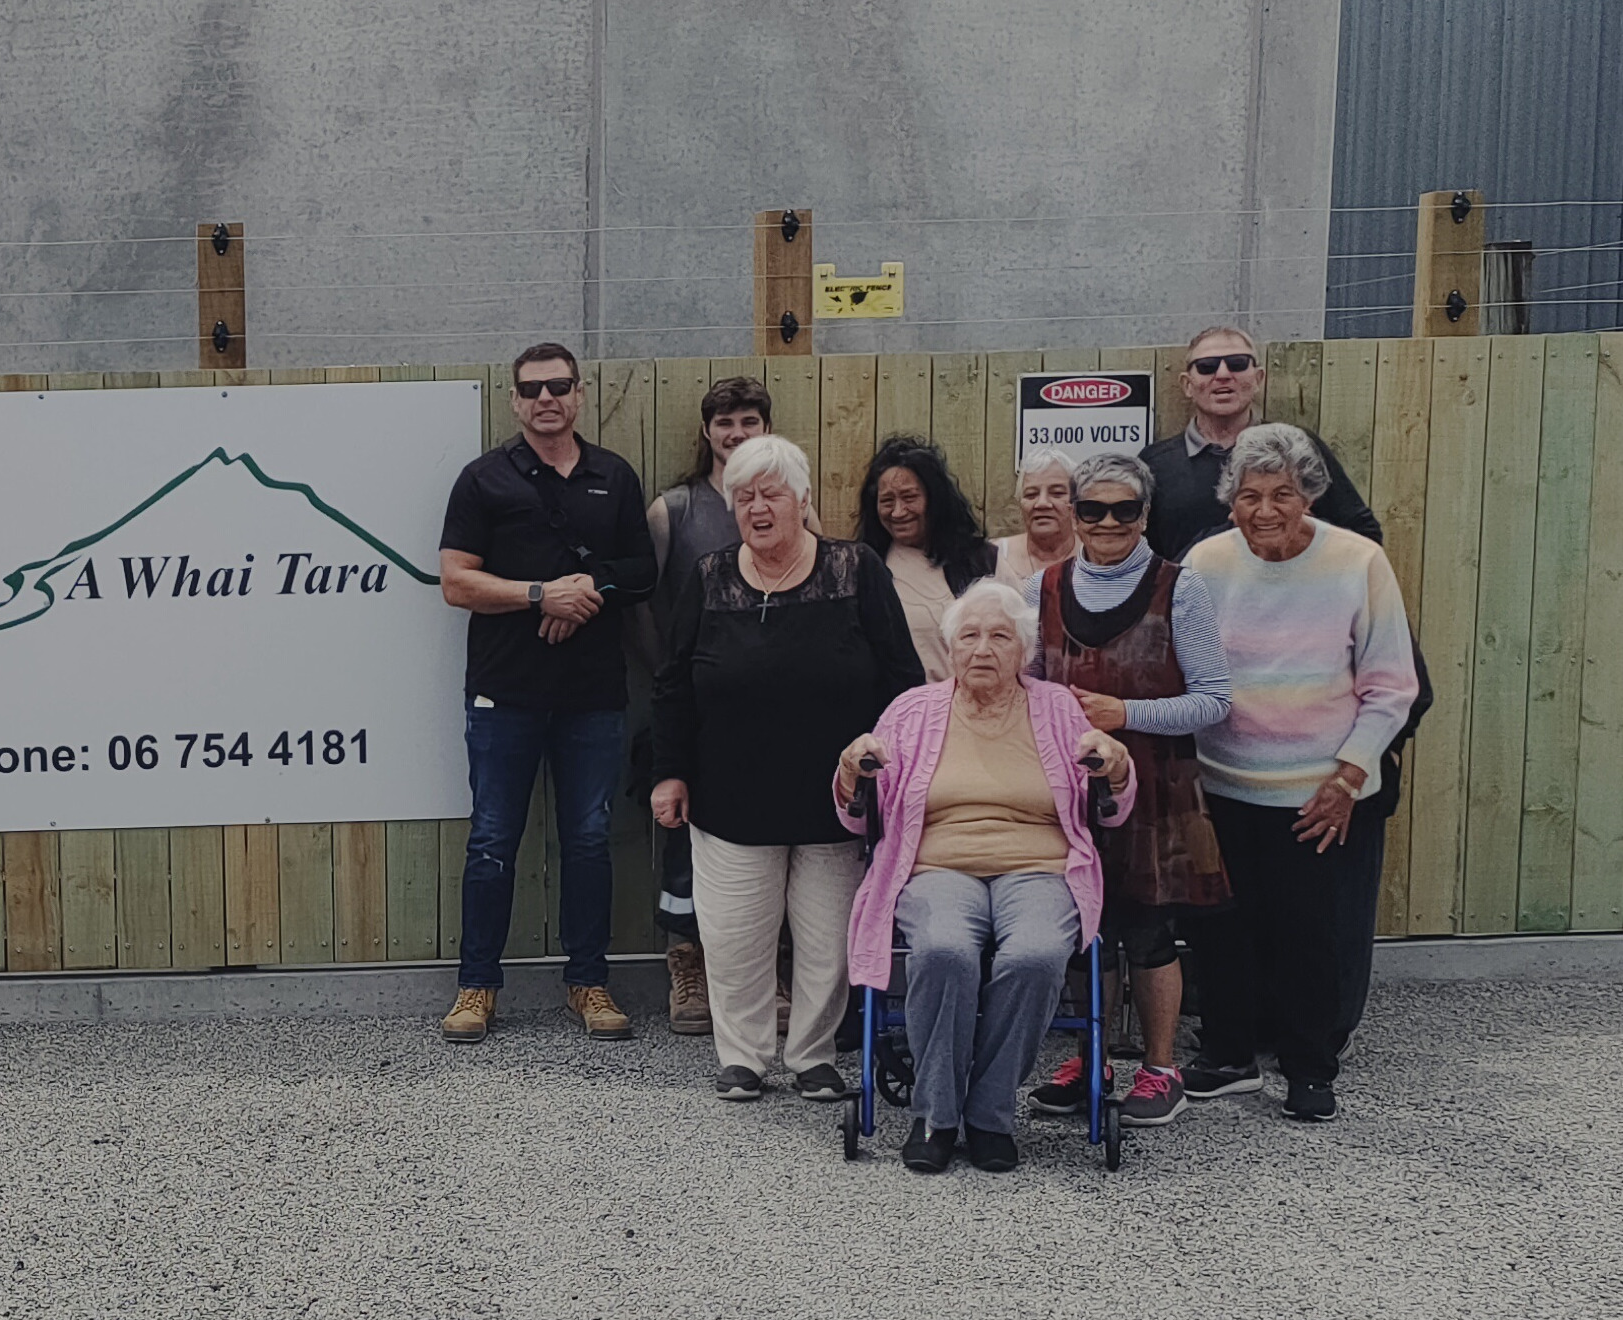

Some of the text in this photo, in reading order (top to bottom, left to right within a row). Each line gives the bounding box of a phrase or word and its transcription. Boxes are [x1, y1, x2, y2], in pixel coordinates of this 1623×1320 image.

[1050, 384, 1121, 400] DANGER
[1029, 425, 1140, 446] 33,000 VOLTS
[64, 557, 103, 600] A
[118, 553, 256, 600] Whai
[277, 552, 389, 595] Tara
[108, 734, 159, 771] 06
[174, 731, 254, 769] 754
[267, 728, 367, 766] 4181
